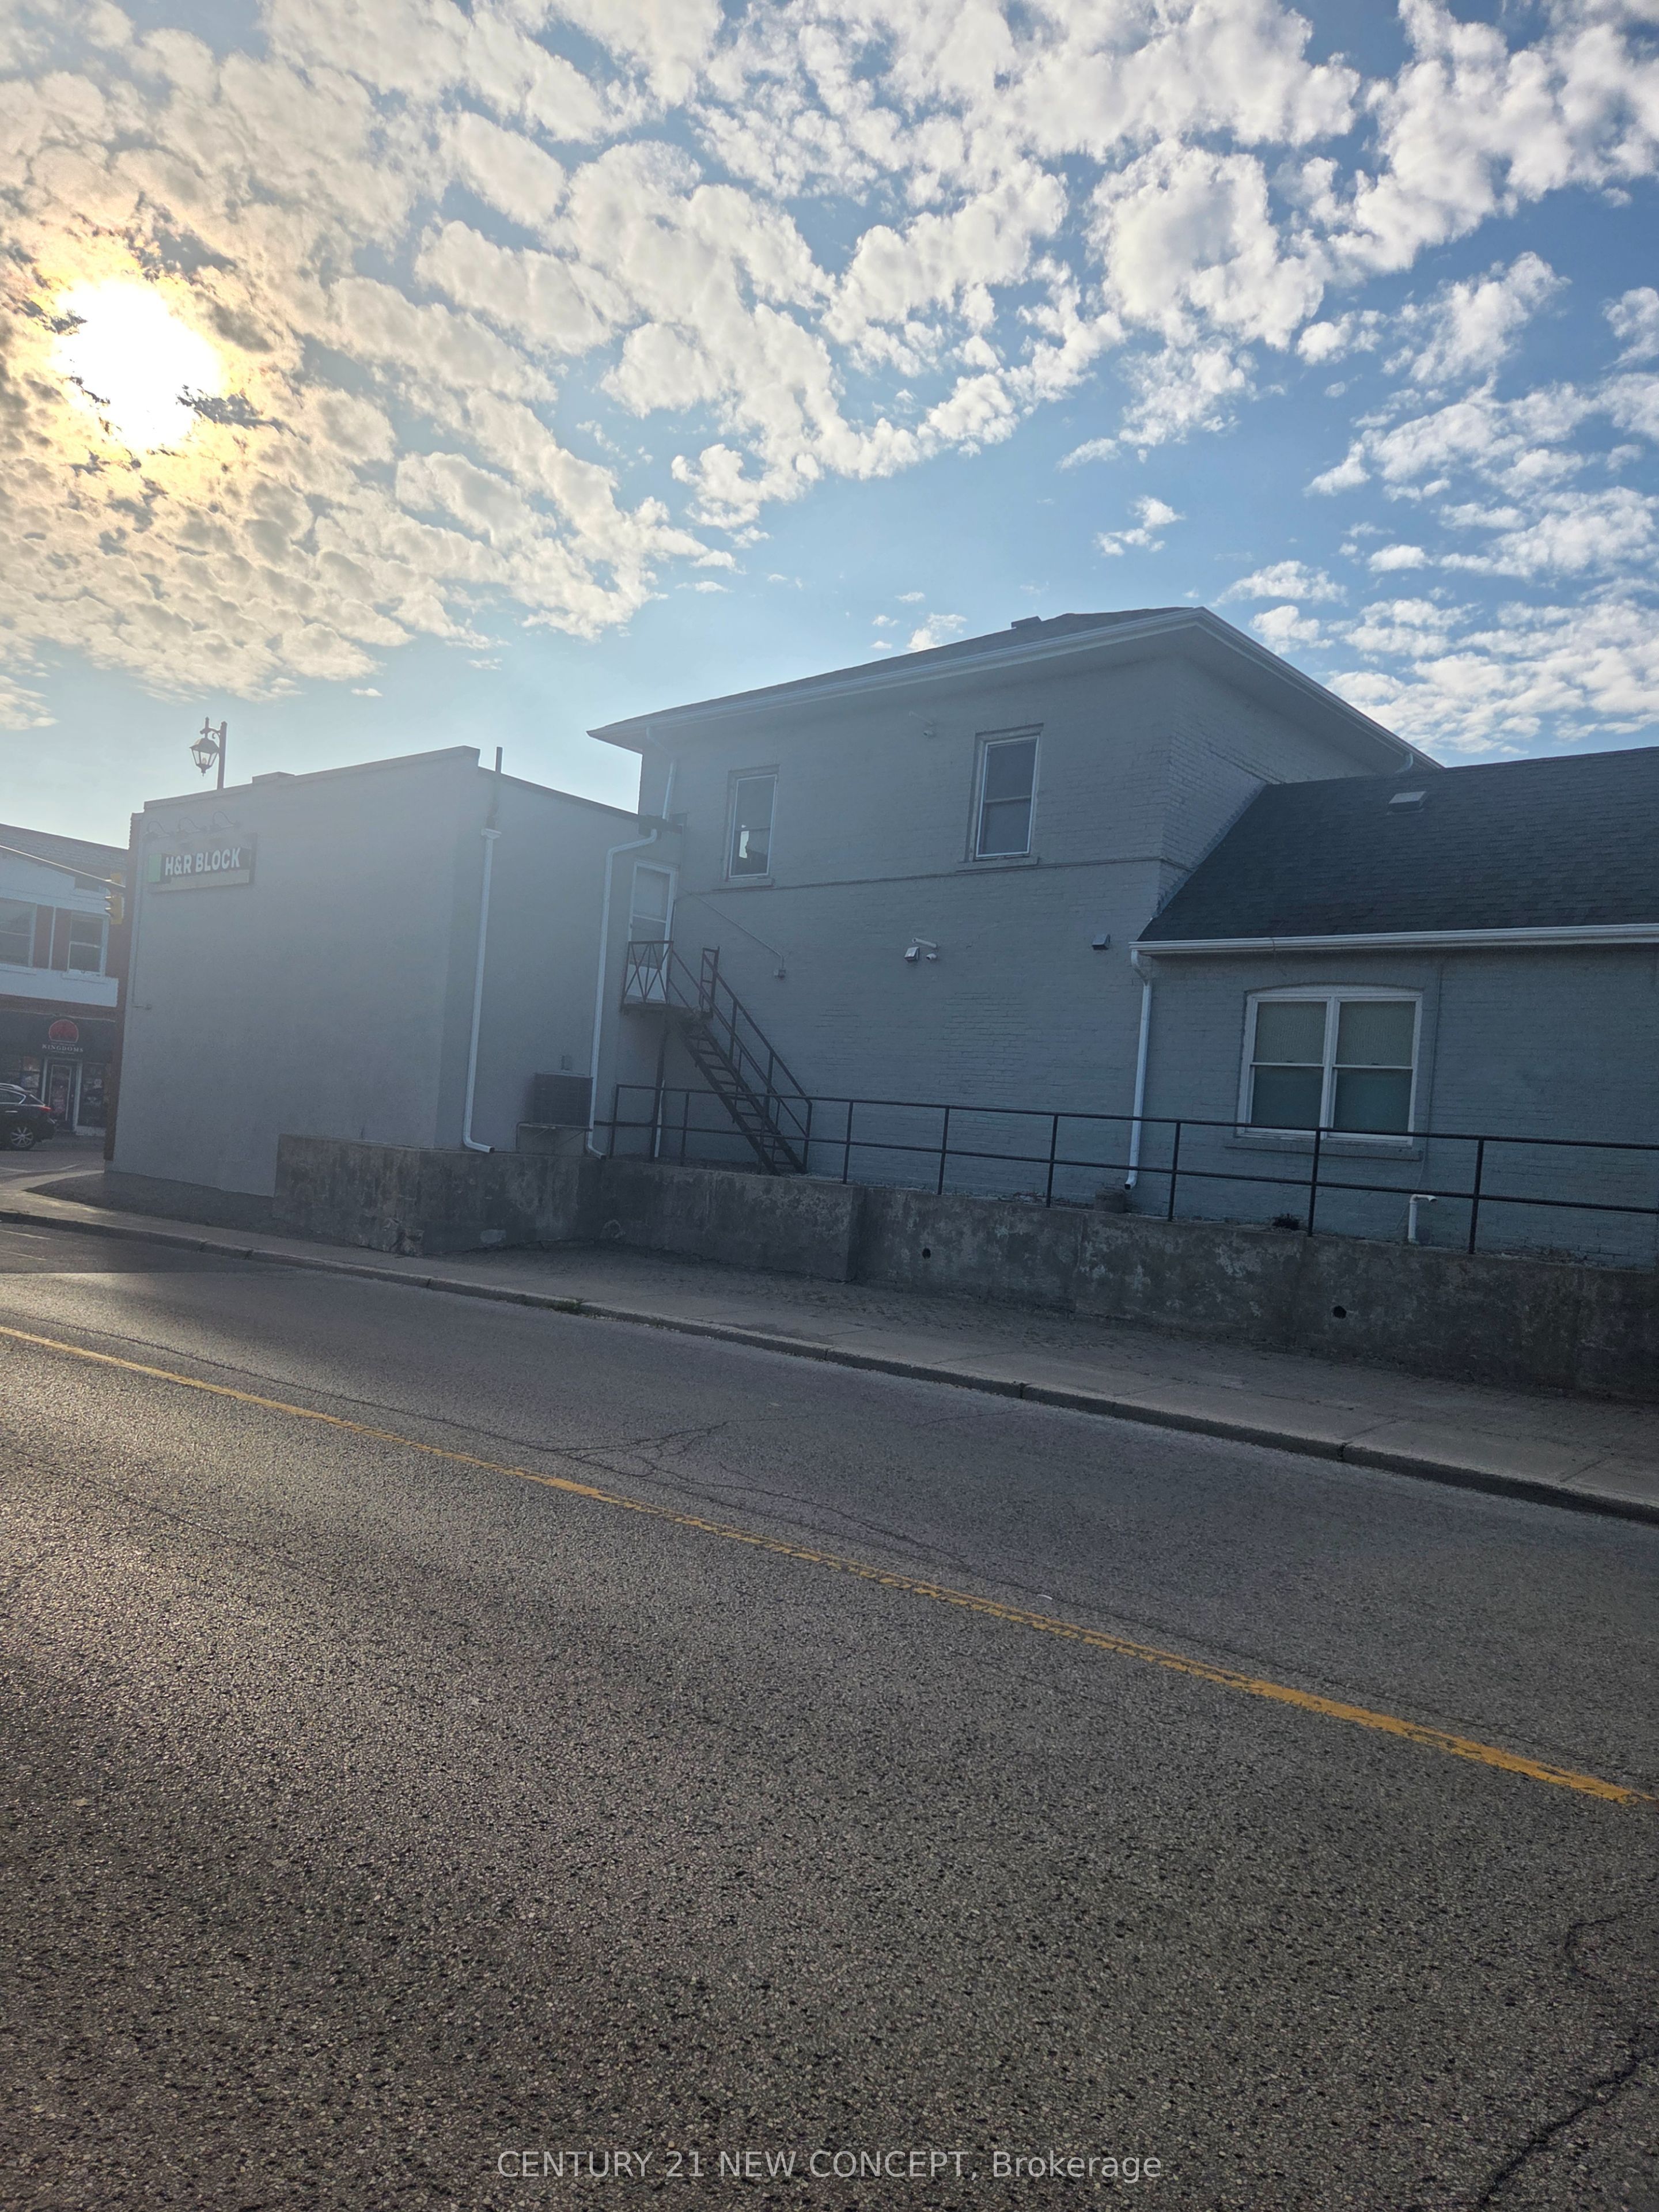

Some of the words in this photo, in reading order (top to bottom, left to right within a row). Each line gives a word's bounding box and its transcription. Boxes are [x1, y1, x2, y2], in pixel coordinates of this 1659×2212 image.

[165, 854, 192, 876] H&R
[195, 847, 241, 873] BLOCK
[42, 1043, 84, 1052] KINGDOMS
